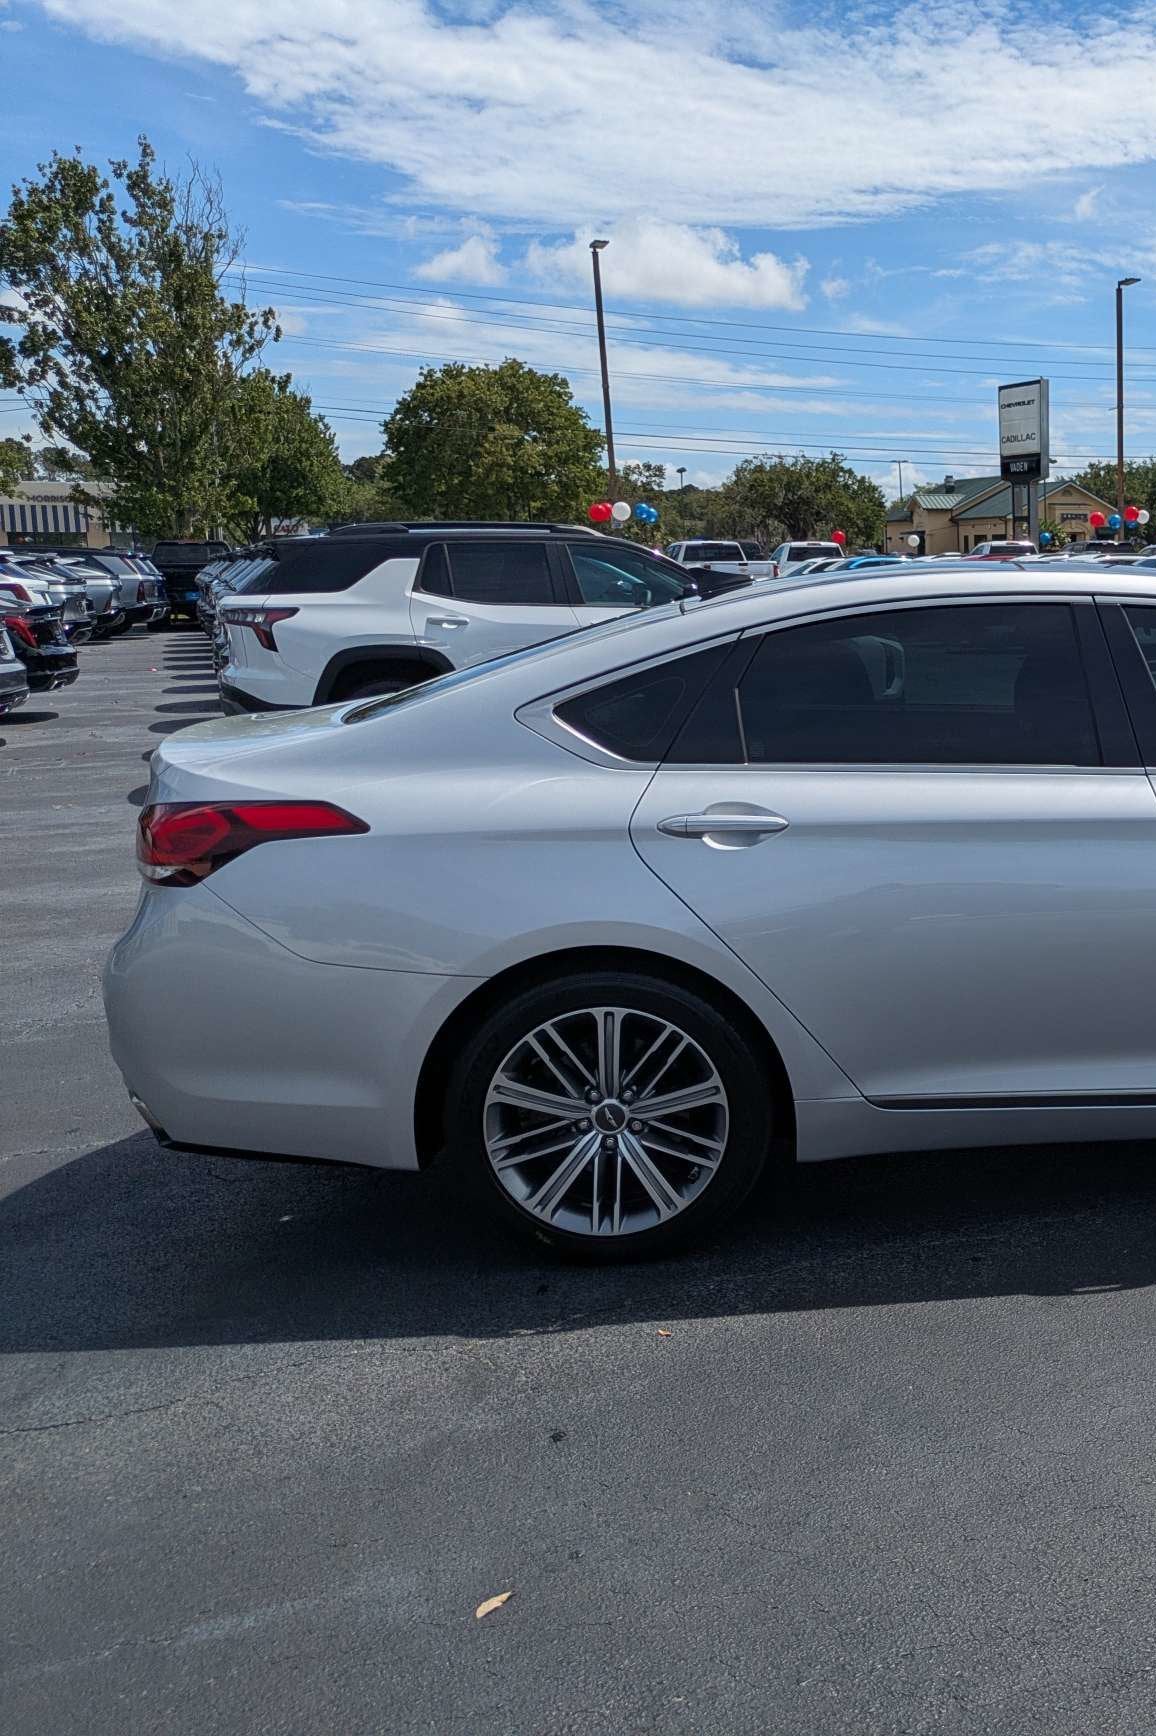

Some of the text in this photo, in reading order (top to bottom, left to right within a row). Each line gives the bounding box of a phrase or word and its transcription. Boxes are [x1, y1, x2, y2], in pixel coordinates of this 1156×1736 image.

[1001, 399, 1035, 410] CHEVROLET
[1002, 433, 1036, 444] CADILLAC
[1010, 462, 1028, 472] VADEN
